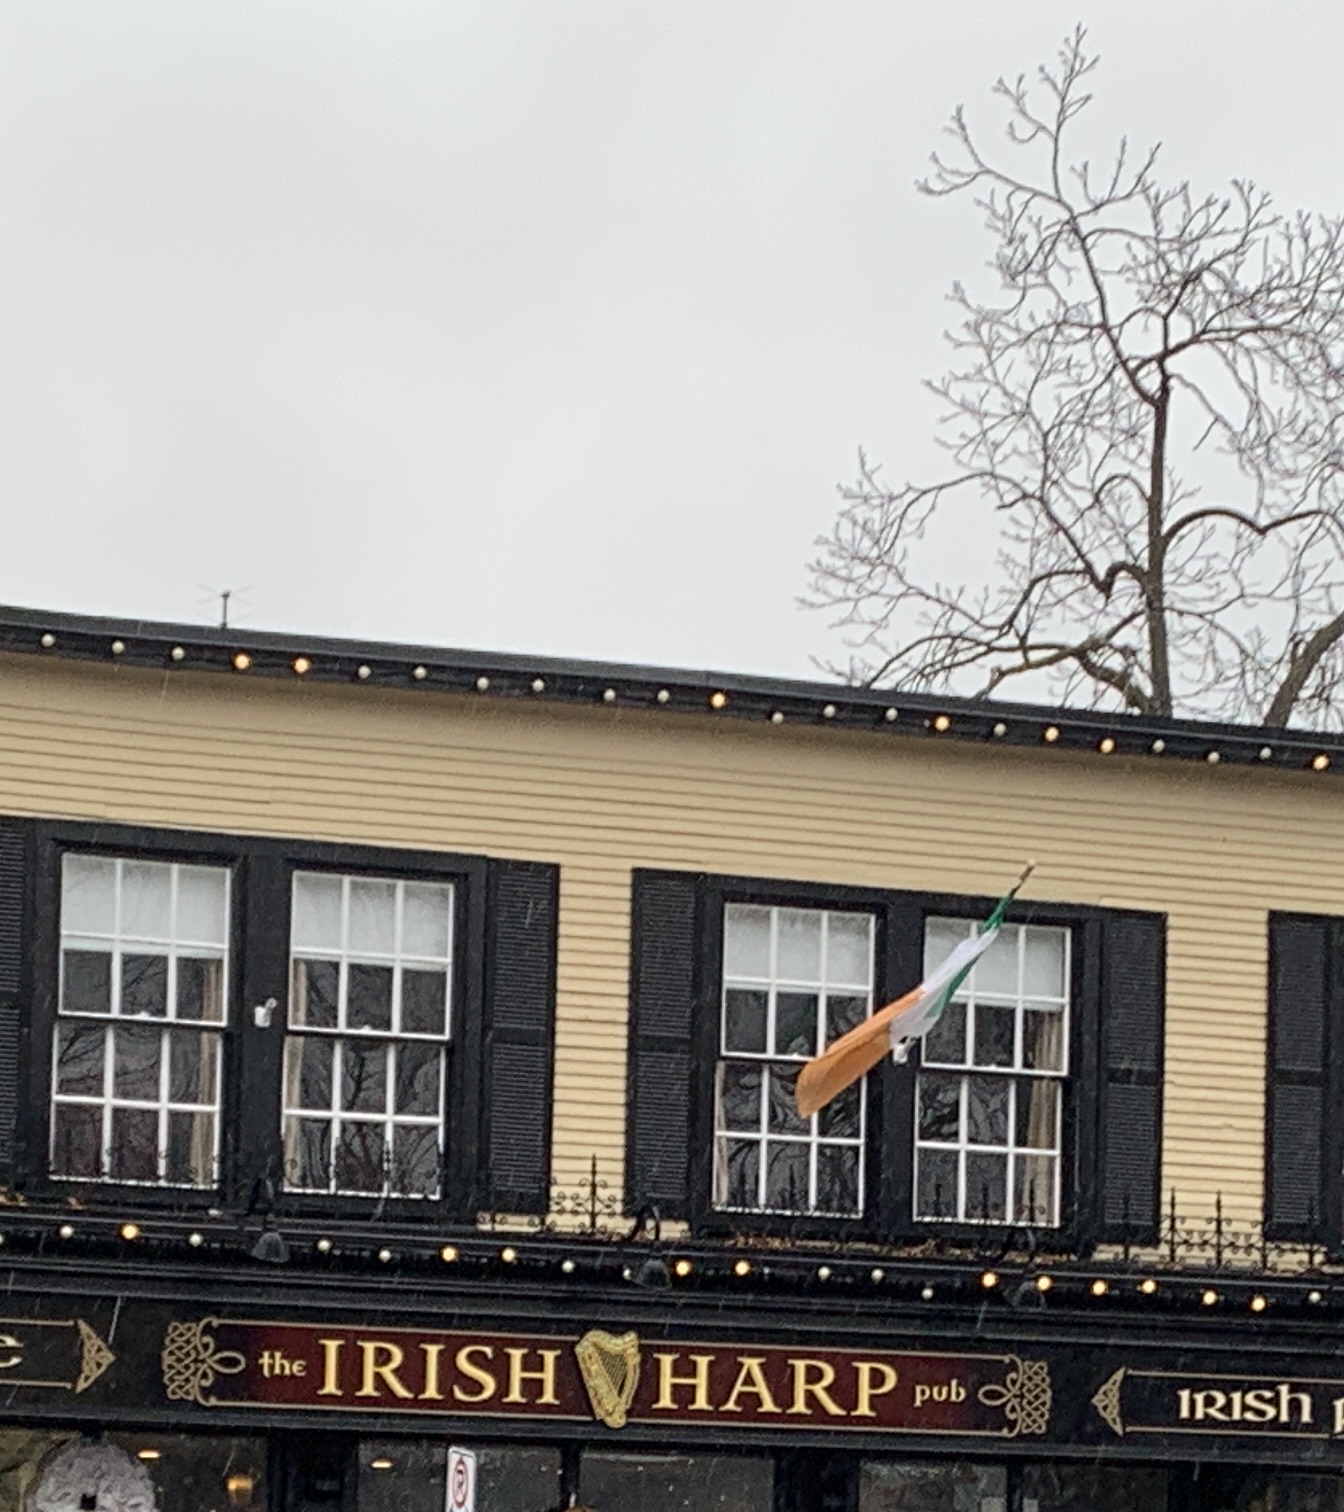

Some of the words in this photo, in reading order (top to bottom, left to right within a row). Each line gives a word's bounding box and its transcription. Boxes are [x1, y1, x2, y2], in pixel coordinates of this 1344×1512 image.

[258, 1350, 307, 1378] the
[316, 1338, 562, 1405] IRISH
[651, 1352, 898, 1417] HARP
[913, 1378, 967, 1408] pub
